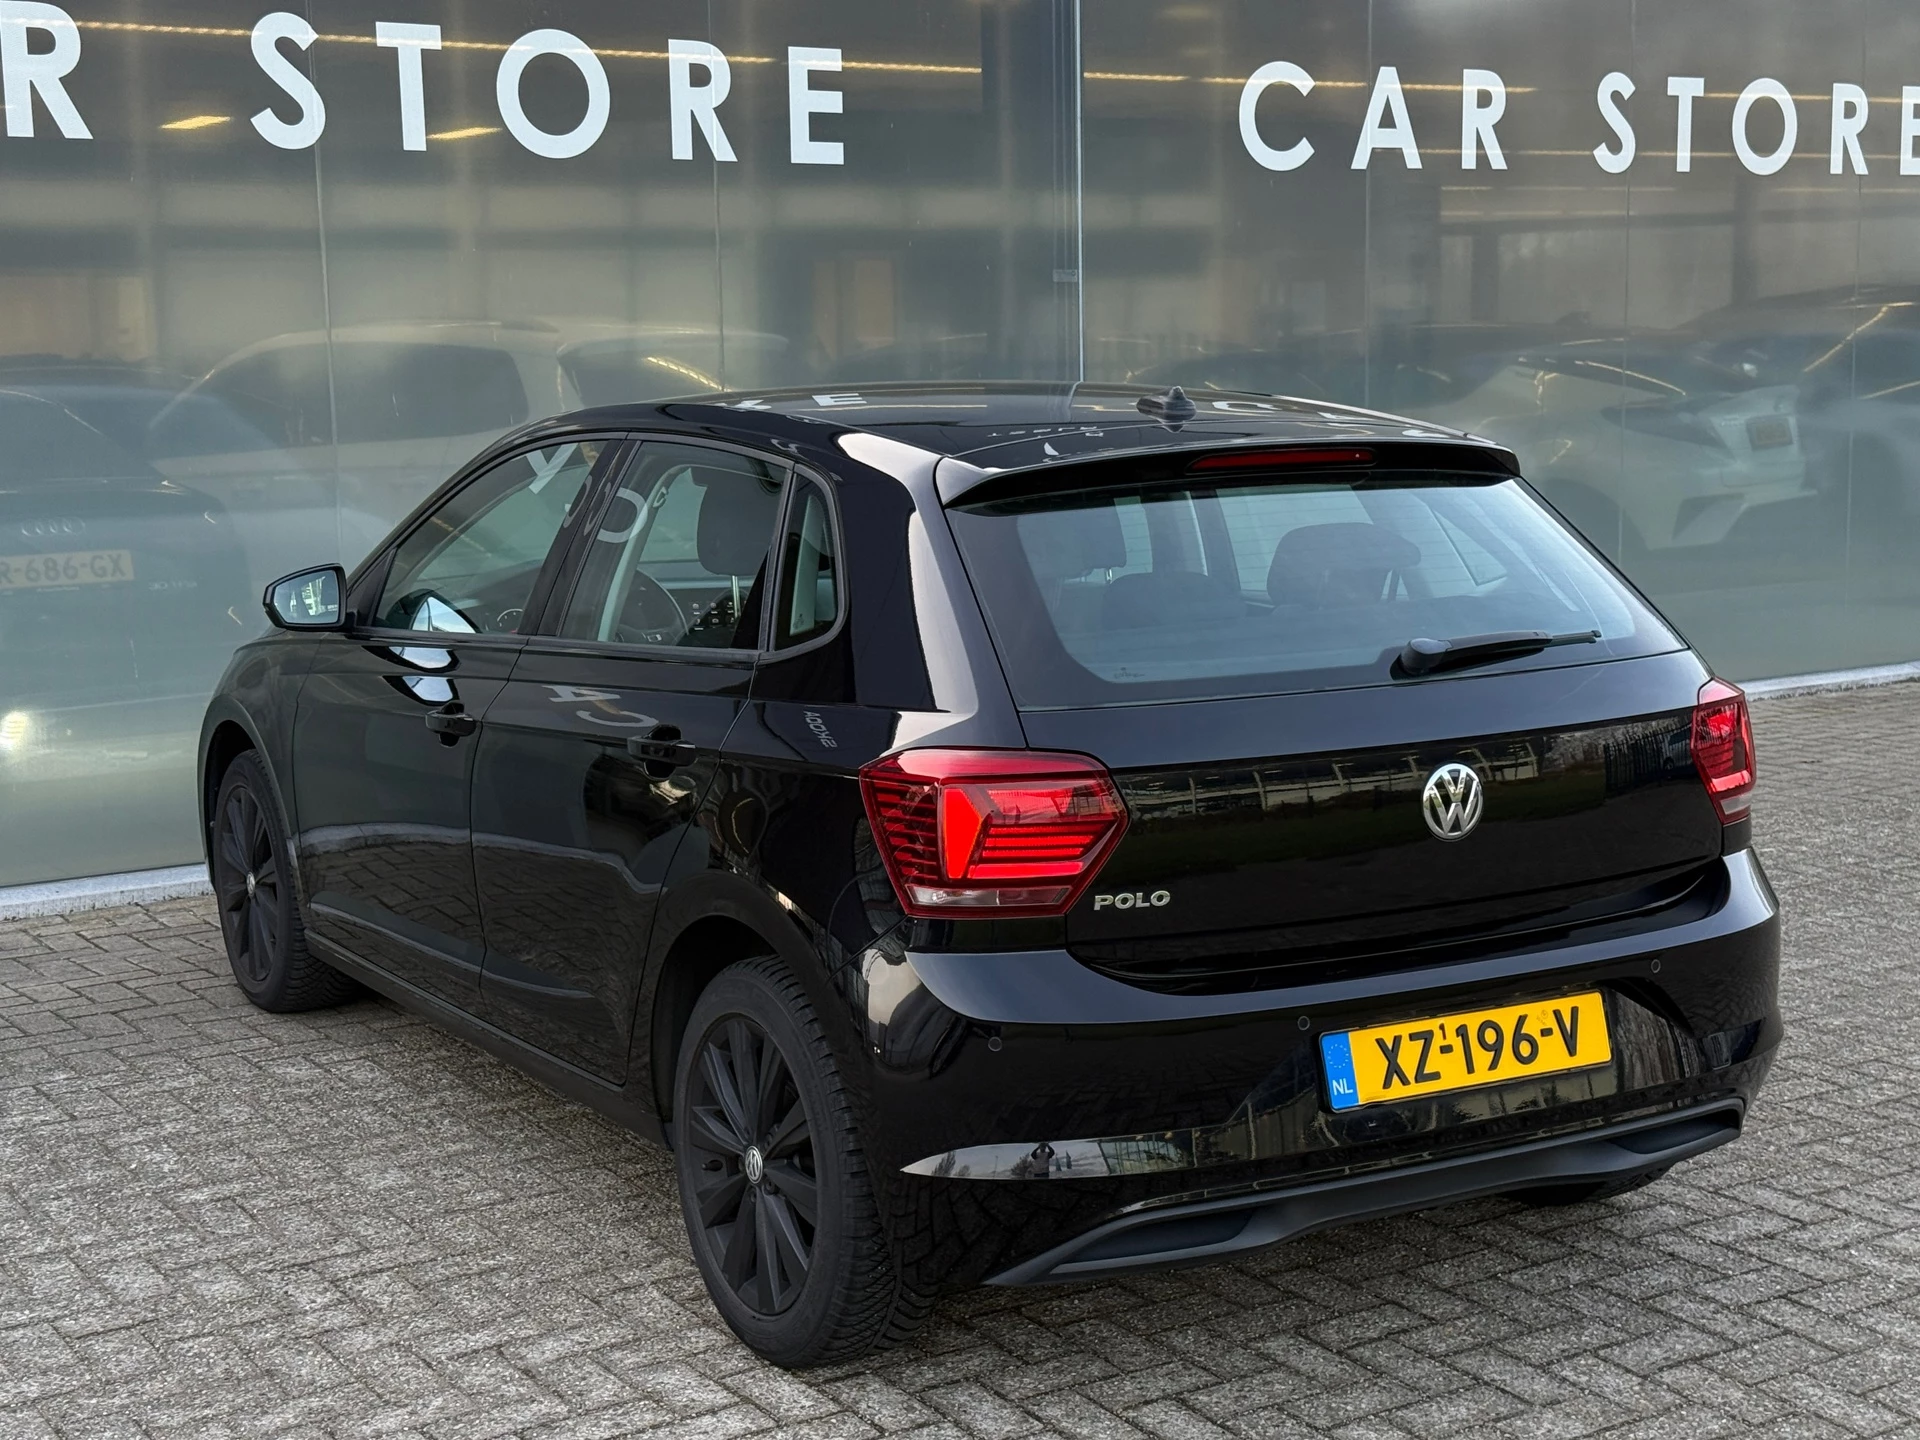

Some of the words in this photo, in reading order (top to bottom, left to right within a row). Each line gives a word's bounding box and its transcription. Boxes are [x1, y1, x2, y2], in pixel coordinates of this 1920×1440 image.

[251, 12, 846, 165] STORE
[1239, 61, 1508, 172] CAR
[1593, 72, 1920, 176] STORE
[1423, 763, 1483, 839] VW
[1093, 890, 1171, 911] POLO
[1331, 1077, 1354, 1096] NL
[1375, 1005, 1579, 1090] XZ-196-V
